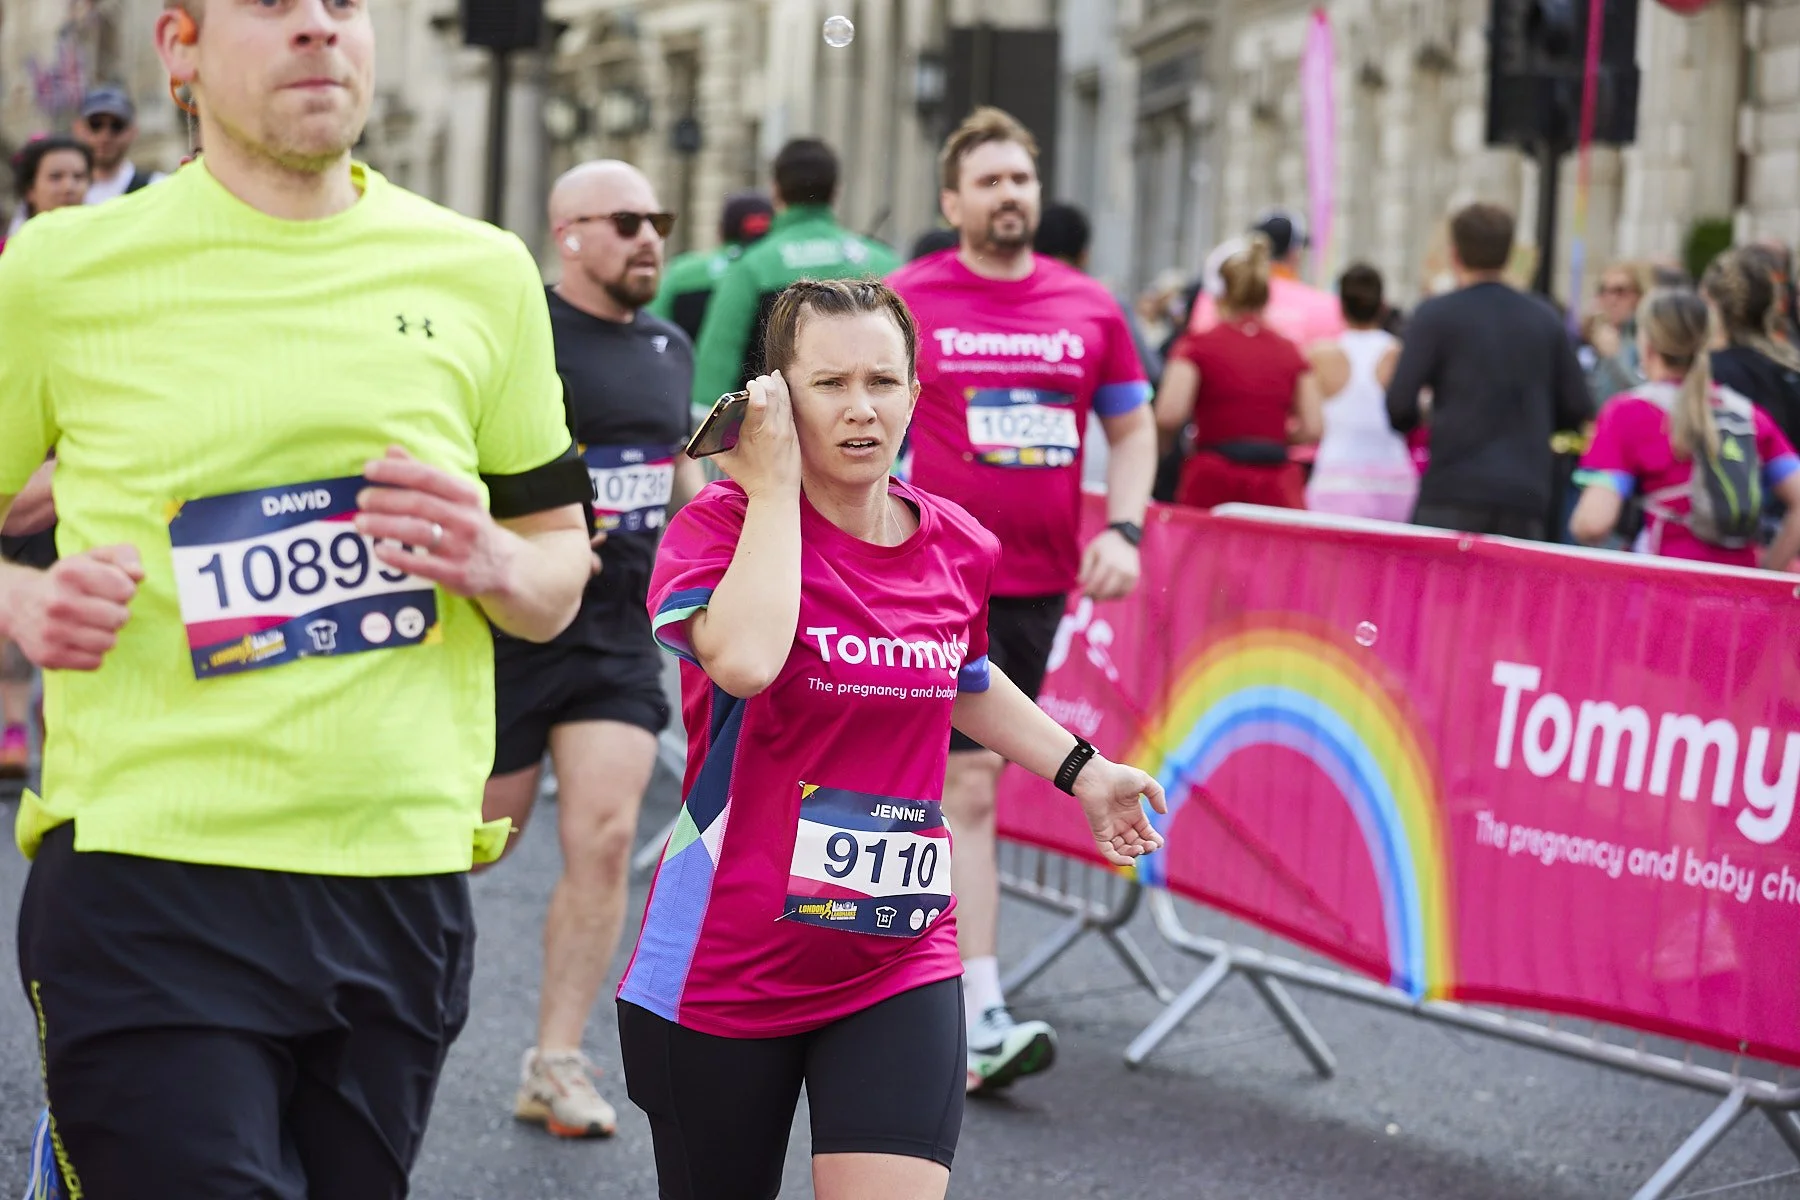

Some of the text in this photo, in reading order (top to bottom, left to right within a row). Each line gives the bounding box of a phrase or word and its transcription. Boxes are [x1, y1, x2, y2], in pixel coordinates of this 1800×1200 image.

[933, 328, 1085, 363] Tommy's
[261, 489, 332, 517] DAVID
[806, 627, 968, 679] Tommy's
[808, 677, 833, 692] The
[837, 683, 907, 699] pregnancy
[911, 686, 934, 698] and
[870, 803, 926, 822] JENNIE
[824, 831, 938, 888] 9110
[1476, 809, 1800, 905] The pregnancy and baby ch
[798, 904, 826, 914] LONDON
